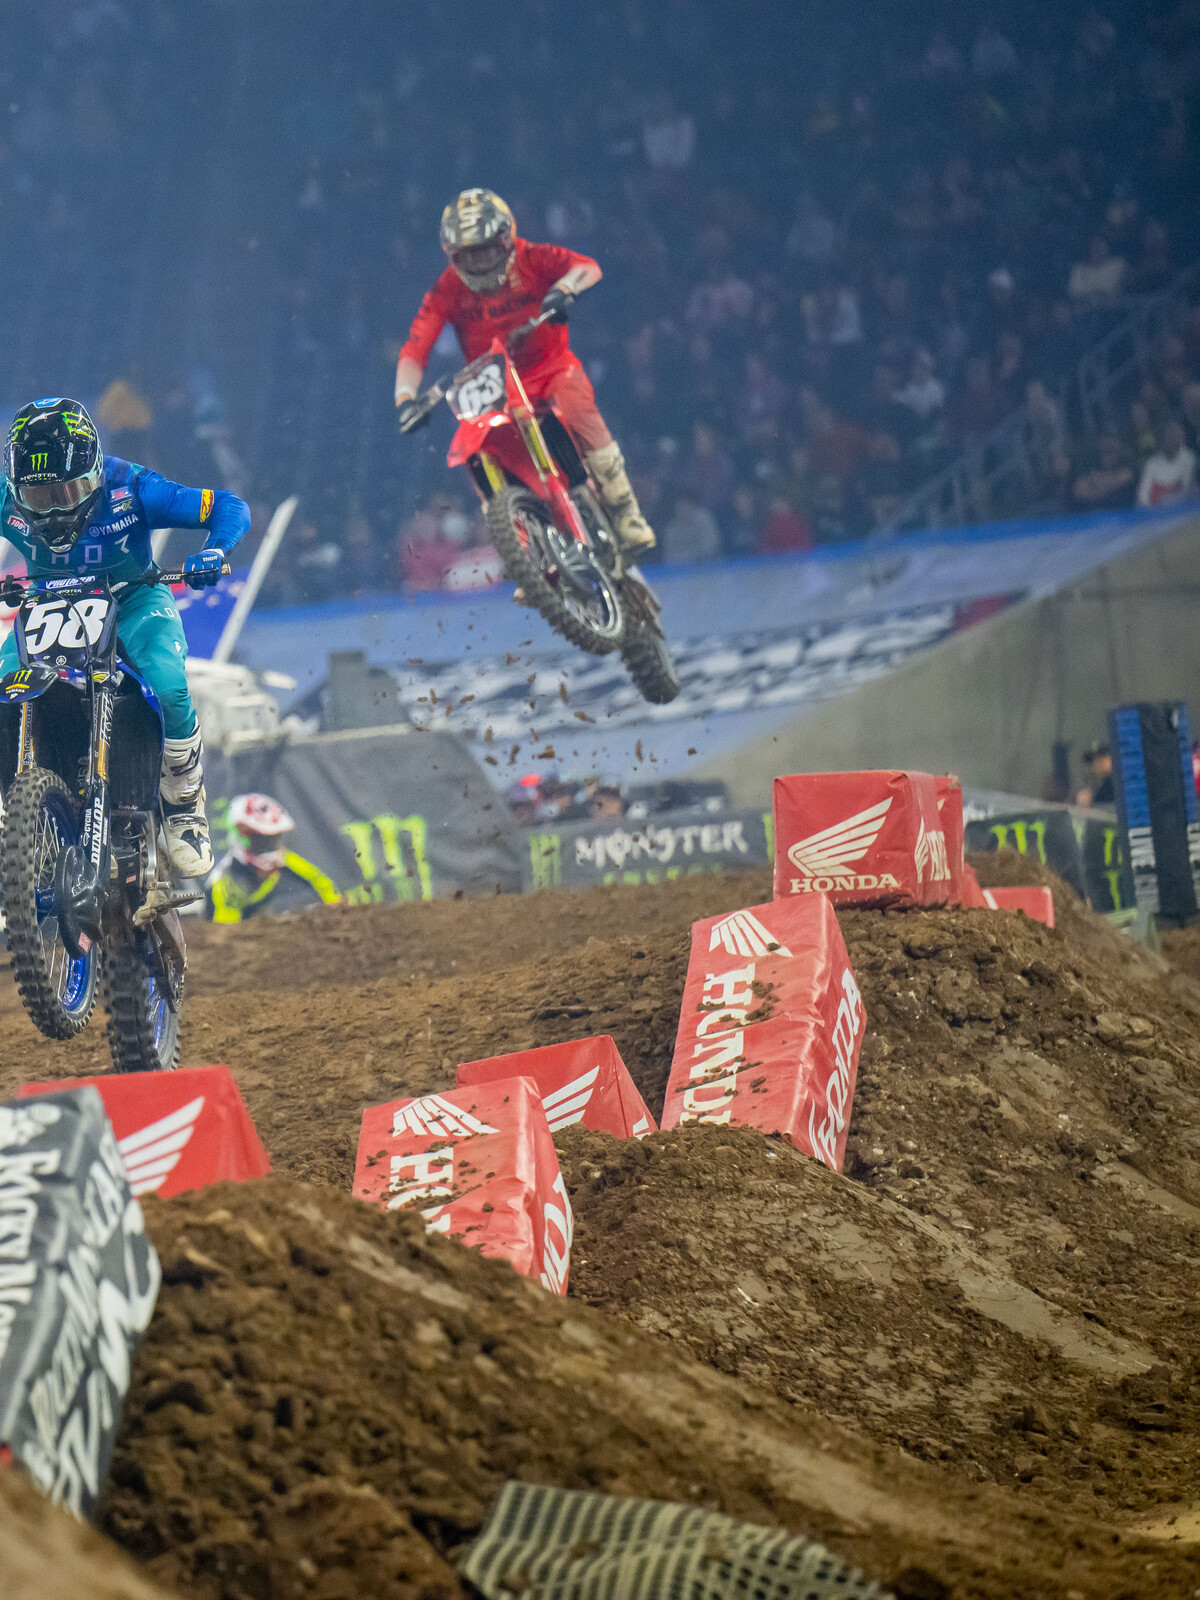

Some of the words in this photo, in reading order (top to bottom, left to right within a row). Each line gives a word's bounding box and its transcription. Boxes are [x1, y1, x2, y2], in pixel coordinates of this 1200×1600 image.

[99, 513, 139, 536] YAMAHA
[24, 598, 109, 656] 58
[91, 796, 103, 865] DUNLOP
[574, 821, 748, 869] MONSTER
[789, 873, 902, 894] HONDA
[681, 962, 756, 1125] HOND
